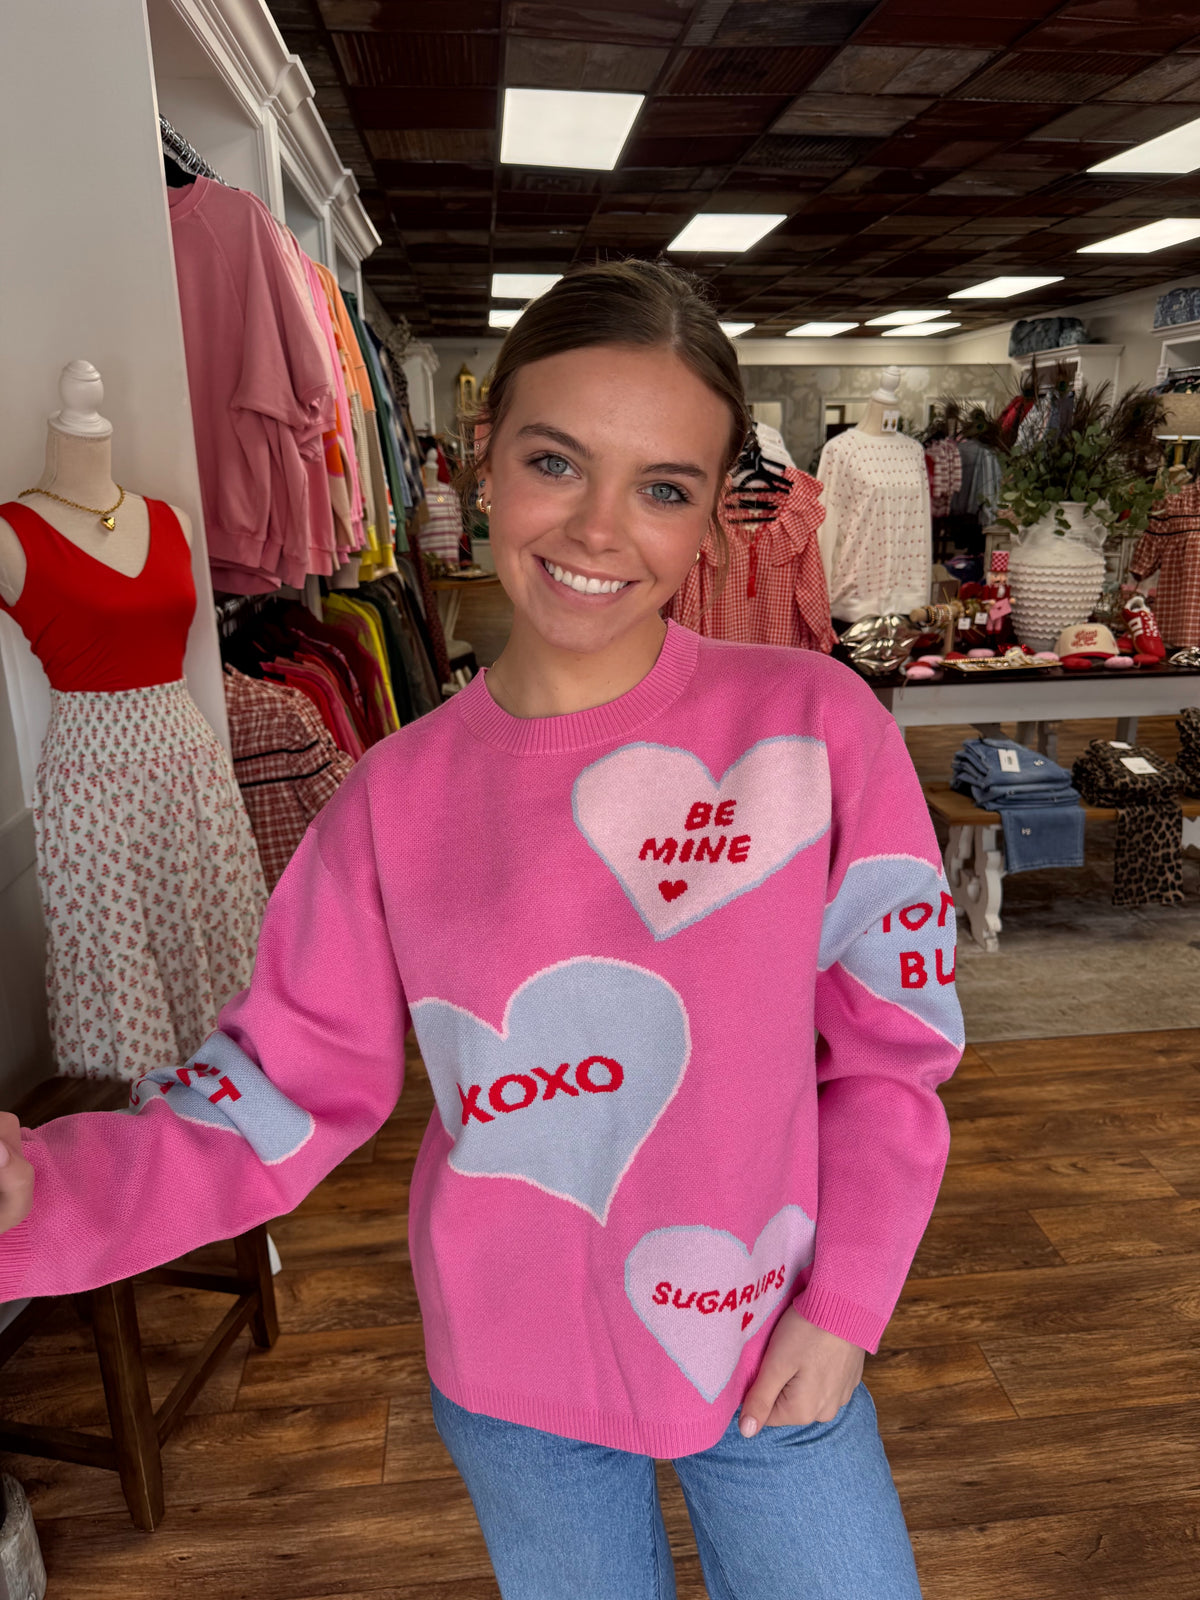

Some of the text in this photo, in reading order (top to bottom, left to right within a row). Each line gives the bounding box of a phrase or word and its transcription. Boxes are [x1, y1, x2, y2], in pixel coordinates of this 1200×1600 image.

[685, 799, 737, 831] BE
[638, 834, 752, 865] MINE
[456, 1055, 625, 1127] XOXO
